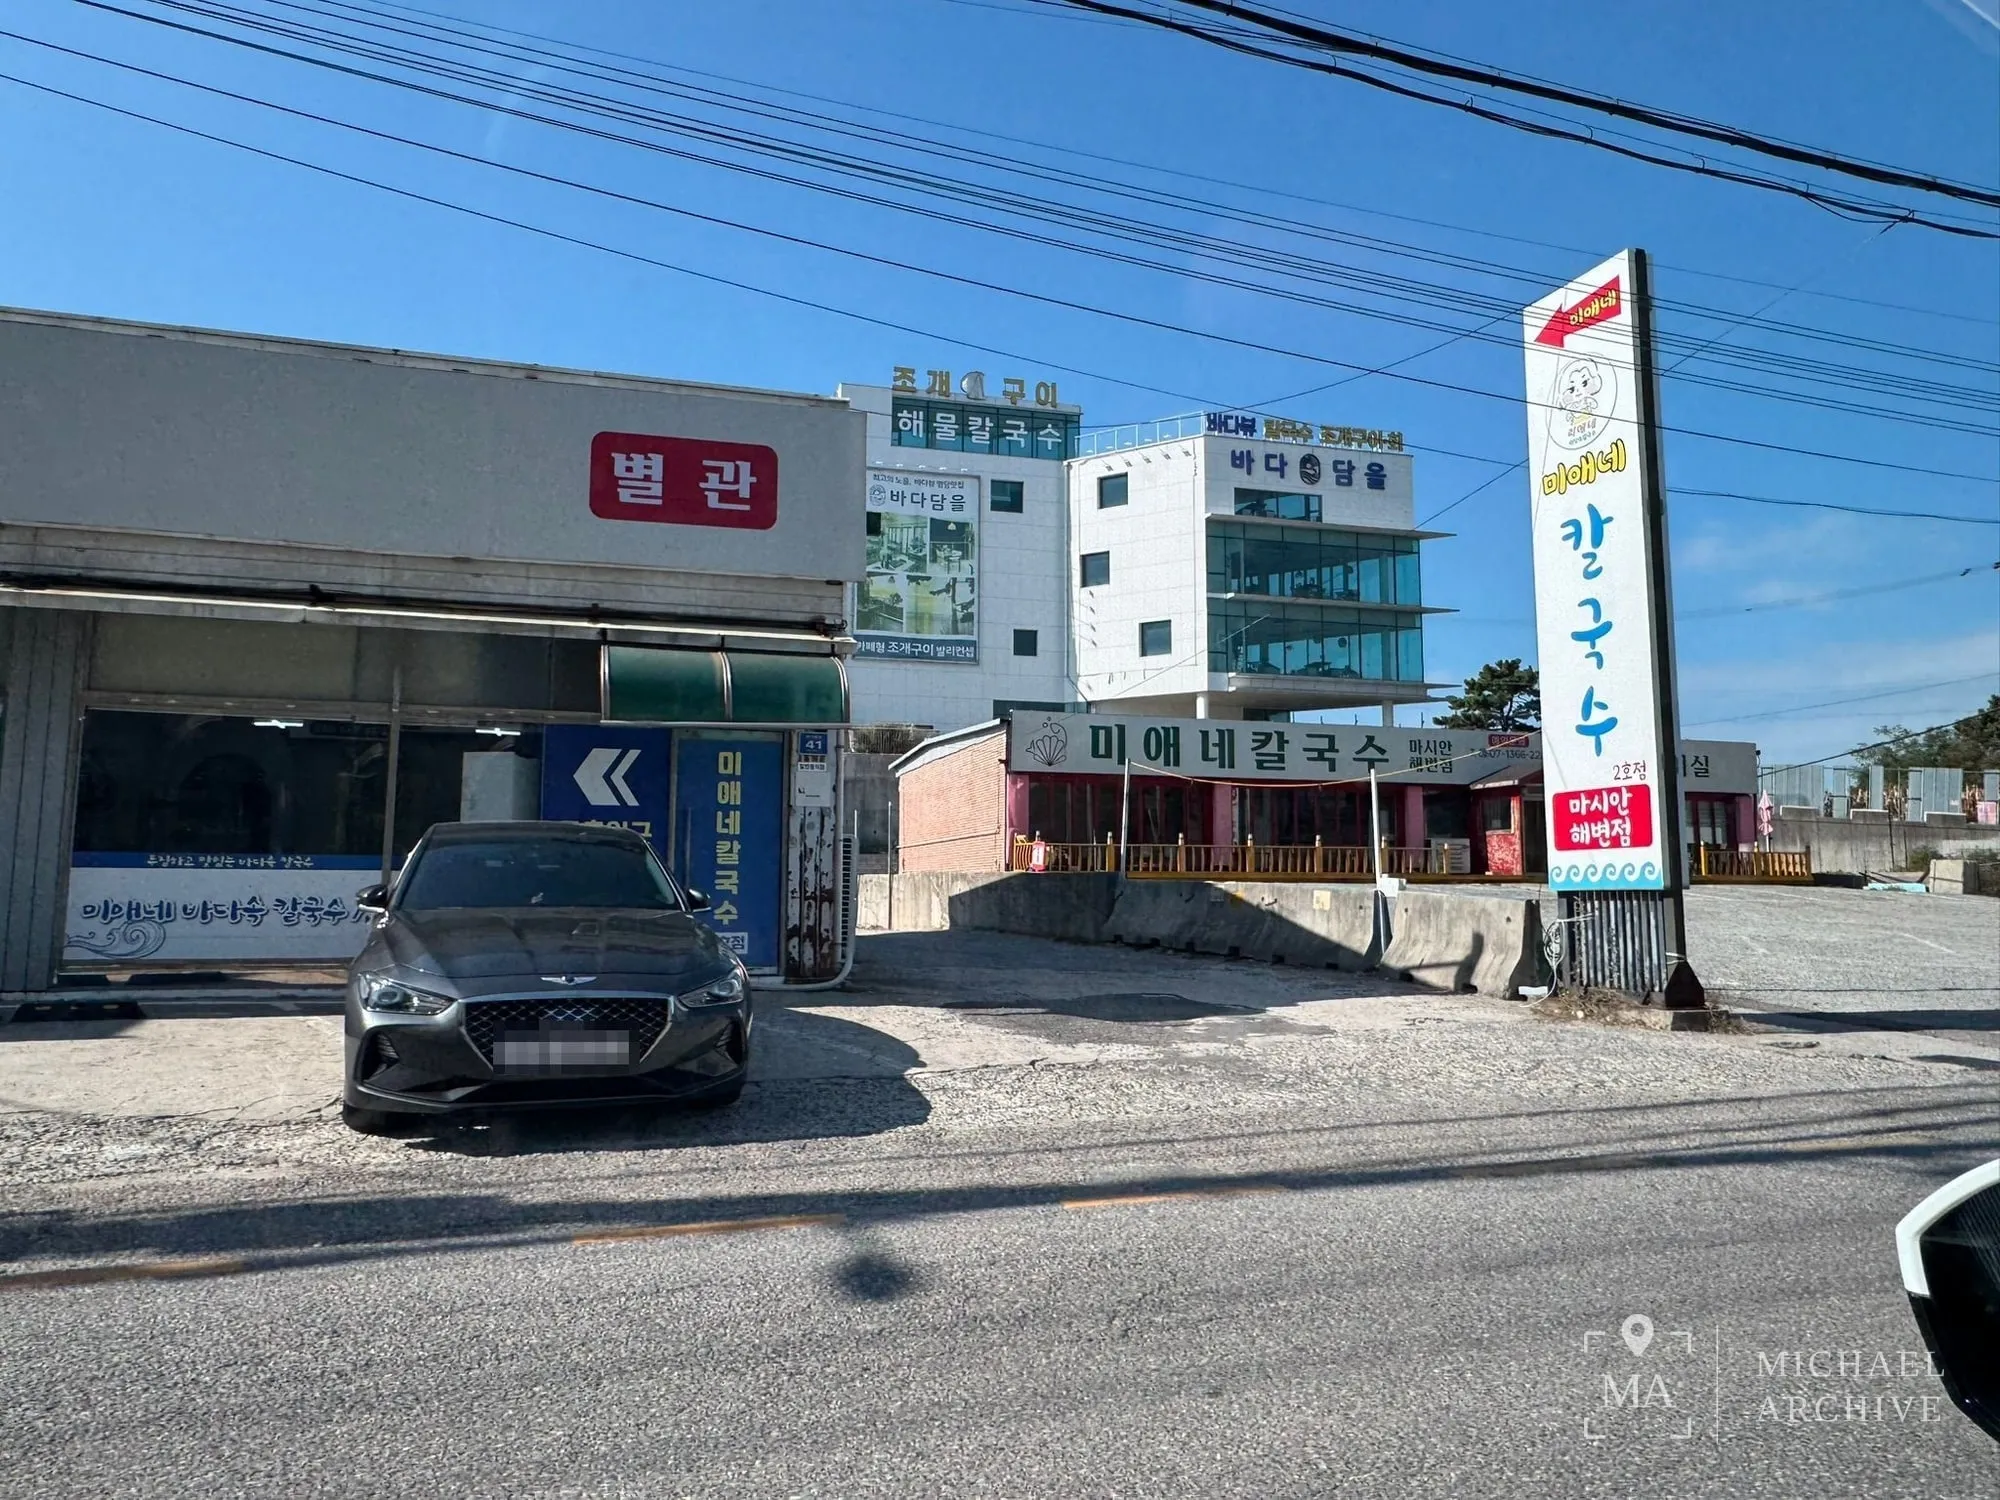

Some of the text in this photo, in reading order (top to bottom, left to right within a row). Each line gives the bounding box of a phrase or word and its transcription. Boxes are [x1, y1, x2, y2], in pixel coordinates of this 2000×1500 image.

[1569, 288, 1617, 326] 미애네
[892, 366, 1058, 409] 조개 구이
[897, 409, 1062, 450] 해물칼국수
[1206, 412, 1257, 437] 바다뷰
[1542, 438, 1626, 496] 미애네
[890, 489, 966, 512] 바다담을
[1560, 503, 1618, 757] 칼국수
[887, 641, 934, 657] 조개구이
[936, 645, 975, 658] 발리컨셉
[805, 740, 822, 750] 41
[1089, 723, 1389, 773] 미애네칼국수
[1409, 738, 1453, 756] 마시안
[1409, 756, 1453, 774] 해변점
[1612, 761, 1647, 781] 2호점
[1681, 753, 1710, 779] 실
[1568, 789, 1633, 817] 마시안
[713, 750, 742, 926] 미애네칼국수
[1569, 819, 1633, 849] 해변점
[271, 895, 350, 927] 칼국수
